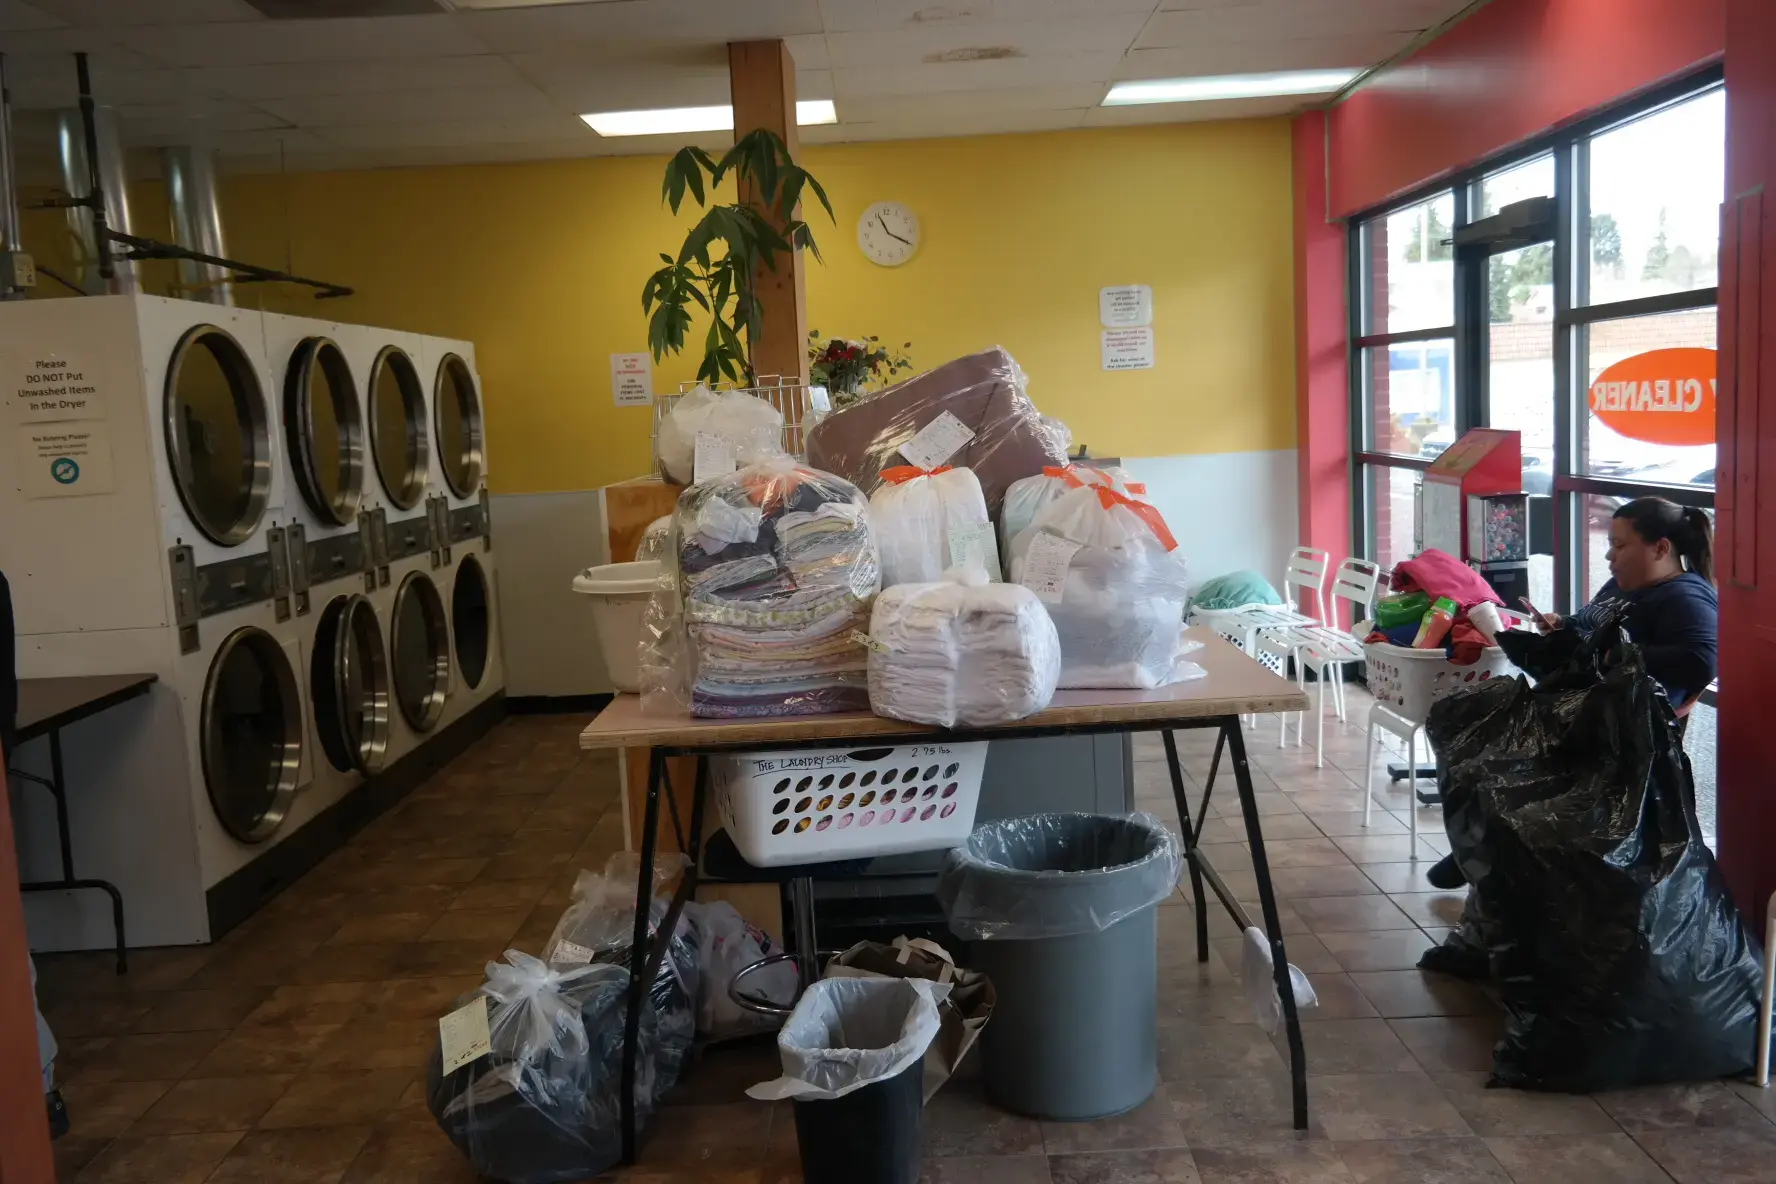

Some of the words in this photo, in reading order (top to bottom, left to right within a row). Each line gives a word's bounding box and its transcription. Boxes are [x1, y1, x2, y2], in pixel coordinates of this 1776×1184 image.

[36, 360, 67, 369] Please
[26, 374, 41, 383] DO
[43, 373, 64, 382] NOT
[66, 372, 83, 381] Put
[18, 386, 67, 397] Unwashed
[69, 386, 96, 394] Items
[29, 402, 39, 411] In
[41, 401, 57, 409] the
[59, 400, 86, 410] Dryer
[753, 760, 774, 772] THE
[780, 756, 824, 769] LAUNDRY
[826, 754, 849, 764] SHOP
